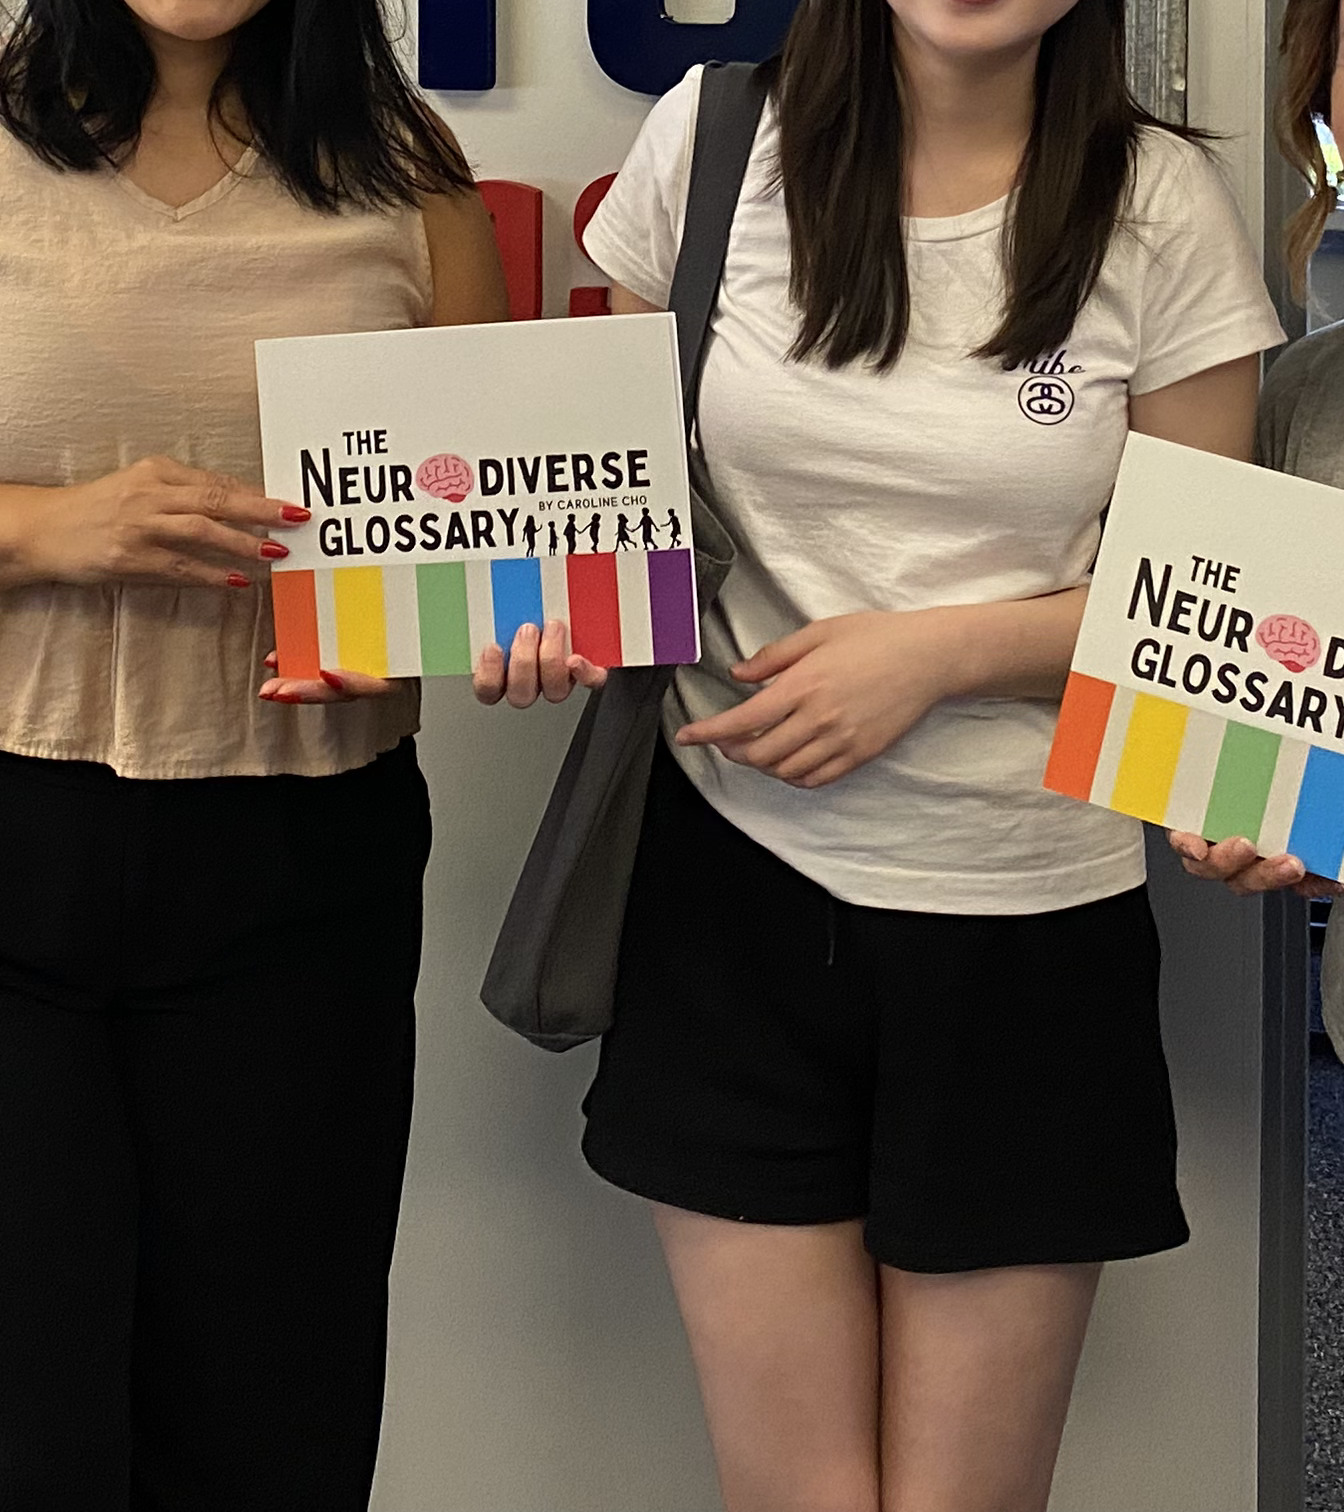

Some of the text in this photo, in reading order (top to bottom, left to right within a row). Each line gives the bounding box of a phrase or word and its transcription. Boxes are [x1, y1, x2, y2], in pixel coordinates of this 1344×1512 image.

[342, 429, 389, 456] THE
[539, 494, 647, 512] BY CAROLINE CHO
[319, 508, 520, 557] GLOSSARY
[1190, 555, 1242, 594] THE
